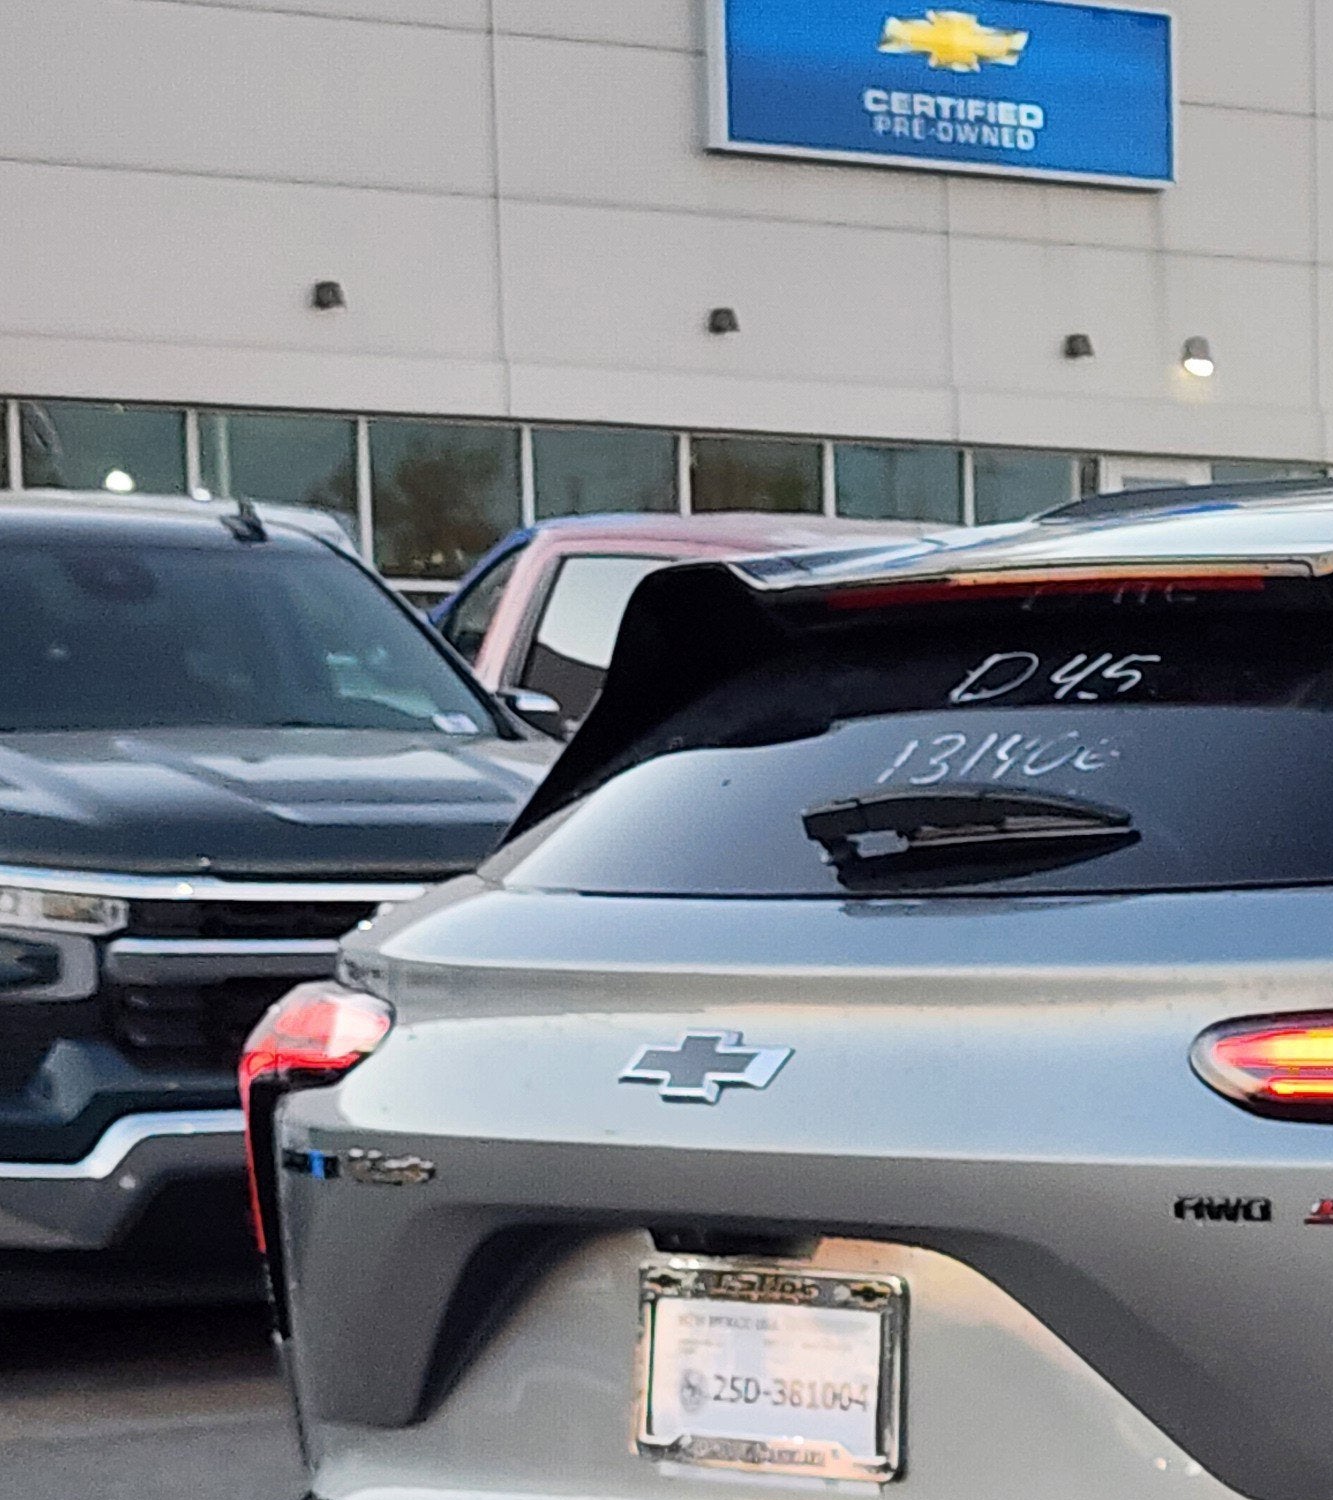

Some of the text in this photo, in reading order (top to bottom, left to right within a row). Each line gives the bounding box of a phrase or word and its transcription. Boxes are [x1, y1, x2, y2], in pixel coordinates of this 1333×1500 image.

[863, 89, 1044, 129] CERTIFIED
[872, 113, 1036, 151] PRE-OWNED
[1173, 1196, 1271, 1222] AWD
